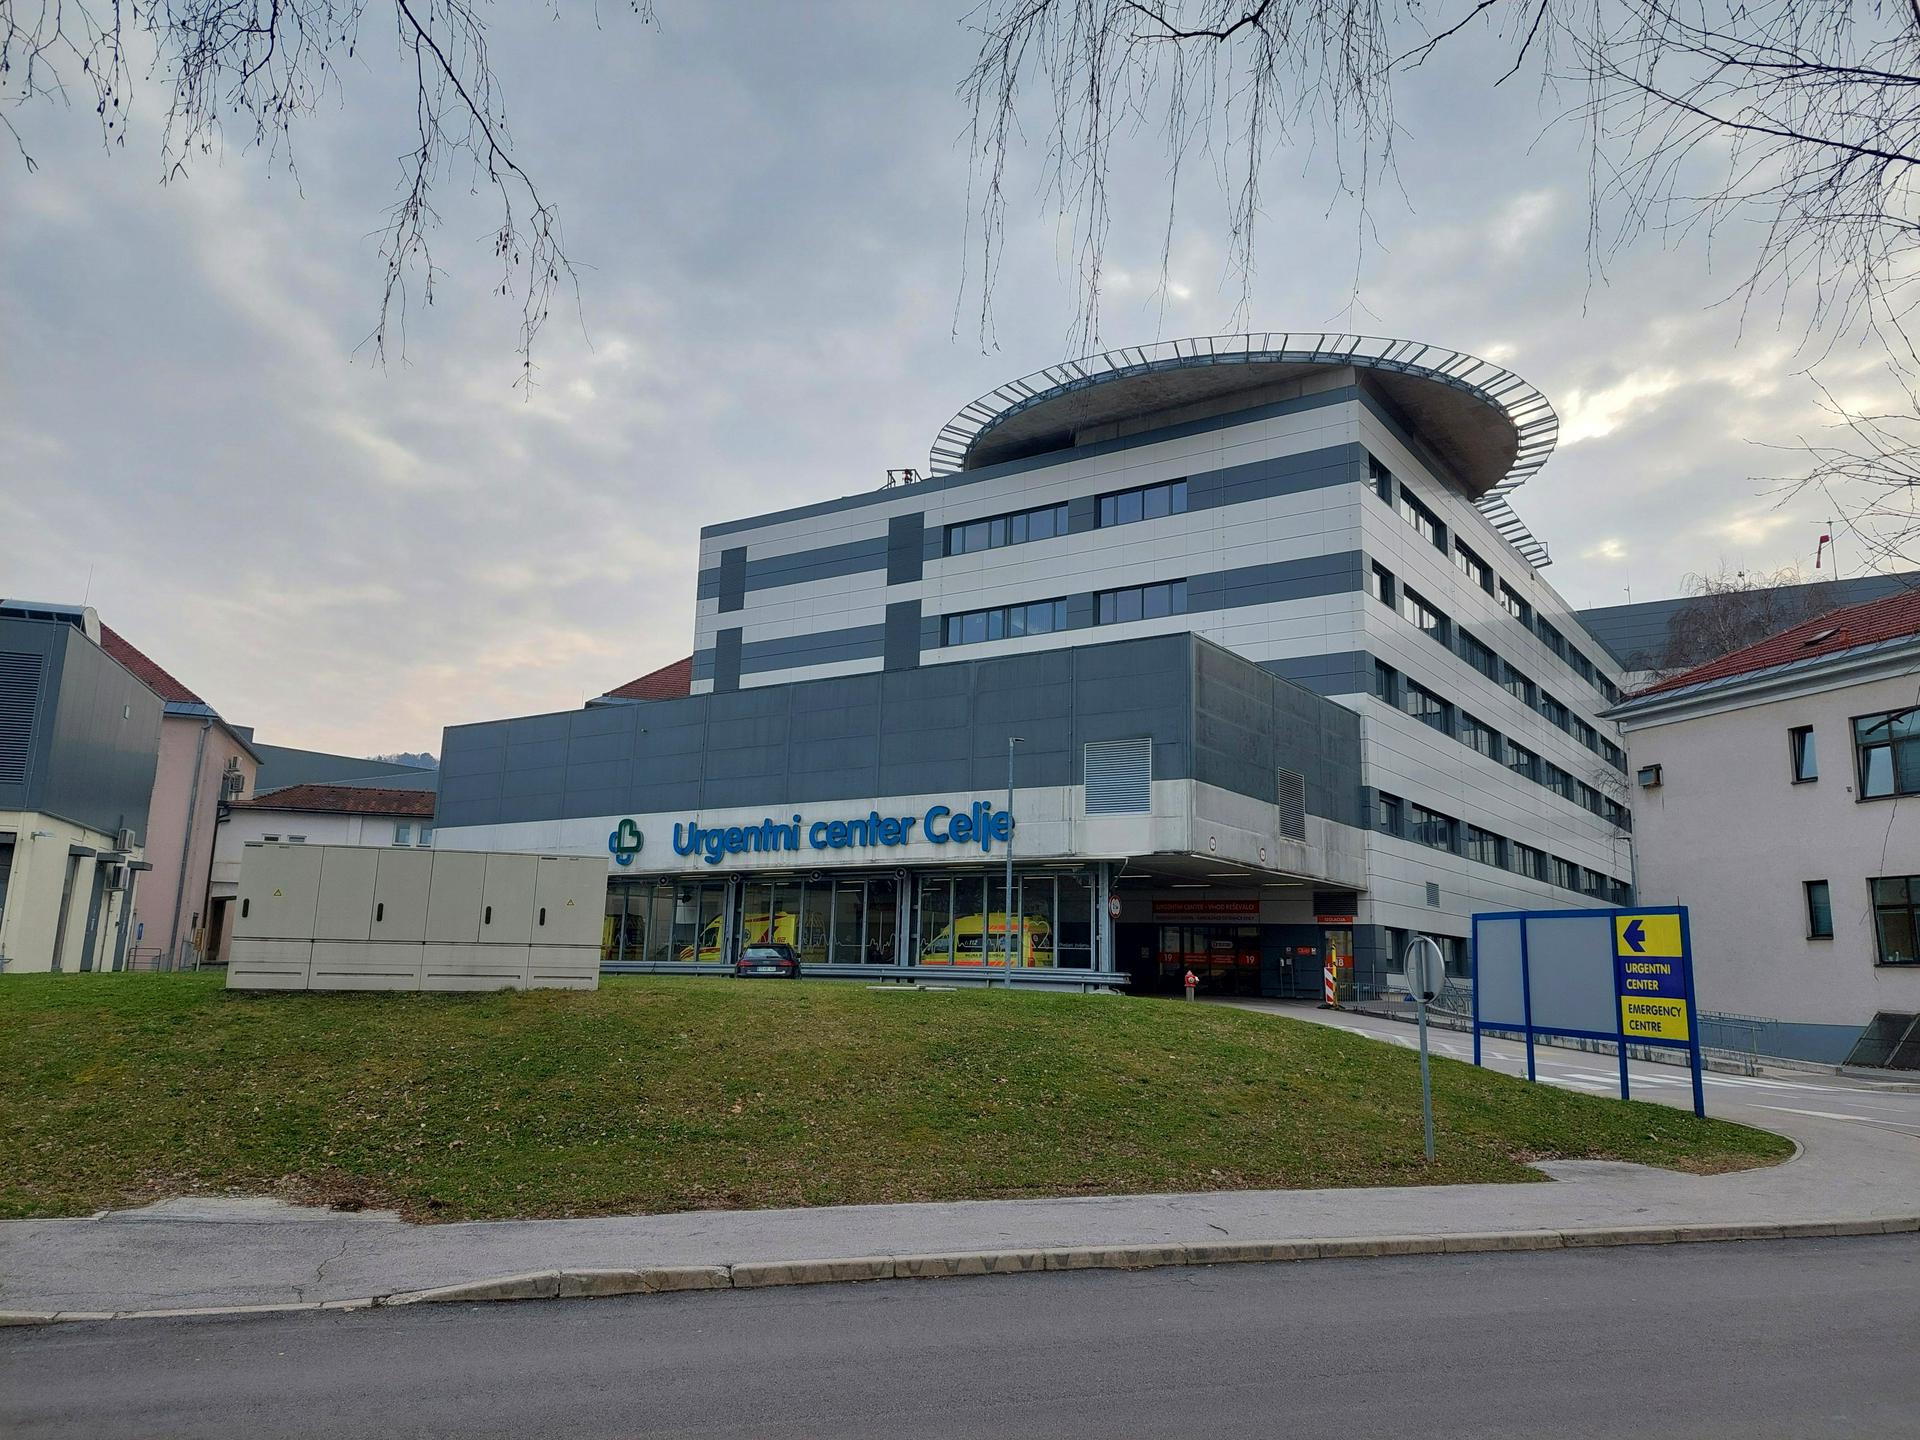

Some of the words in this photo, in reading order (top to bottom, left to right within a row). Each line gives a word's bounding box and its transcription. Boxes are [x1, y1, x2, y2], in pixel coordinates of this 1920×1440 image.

[673, 814, 801, 866] Urgentni
[809, 811, 917, 850] center
[924, 800, 1016, 852] Celje
[1625, 963, 1671, 975] URGENTNI
[1626, 979, 1659, 991] CENTER
[1628, 1004, 1682, 1017] EMERGENCY
[1629, 1020, 1662, 1032] CENTRE
